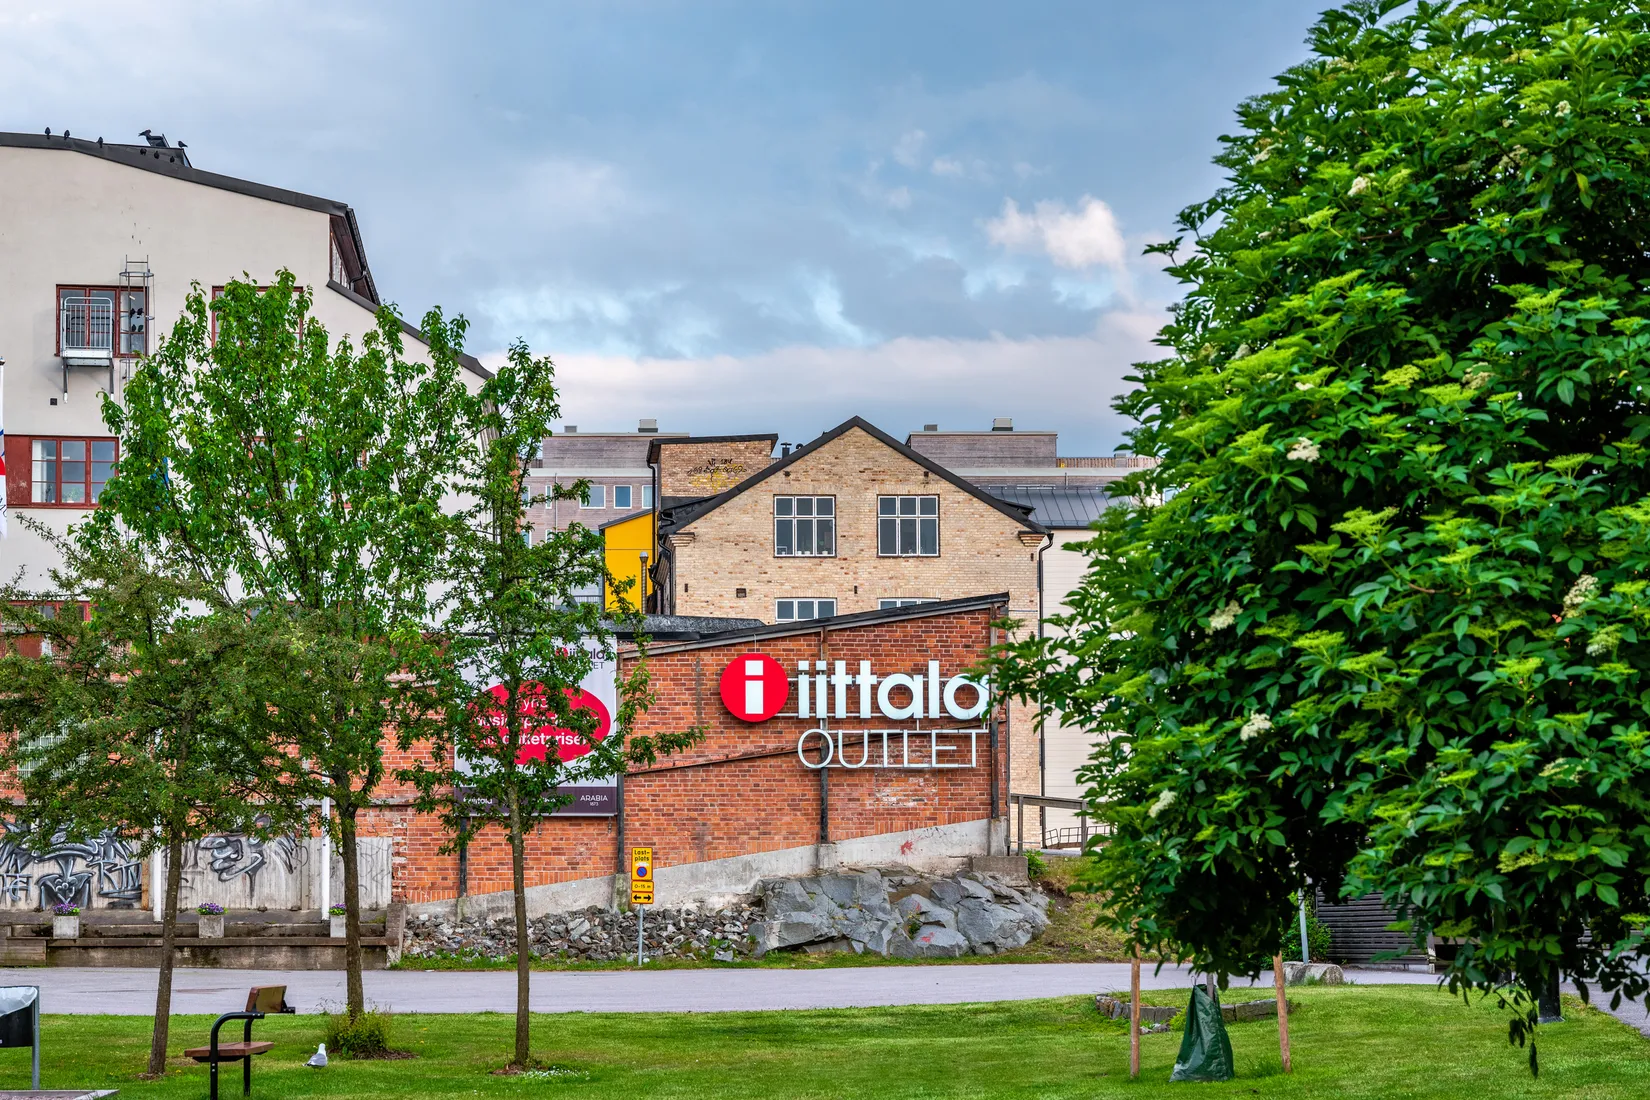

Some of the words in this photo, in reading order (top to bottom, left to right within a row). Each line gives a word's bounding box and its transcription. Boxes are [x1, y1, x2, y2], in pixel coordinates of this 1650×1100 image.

[798, 660, 990, 720] iittala
[797, 728, 989, 769] OUTLET
[580, 794, 609, 802] ARABIA
